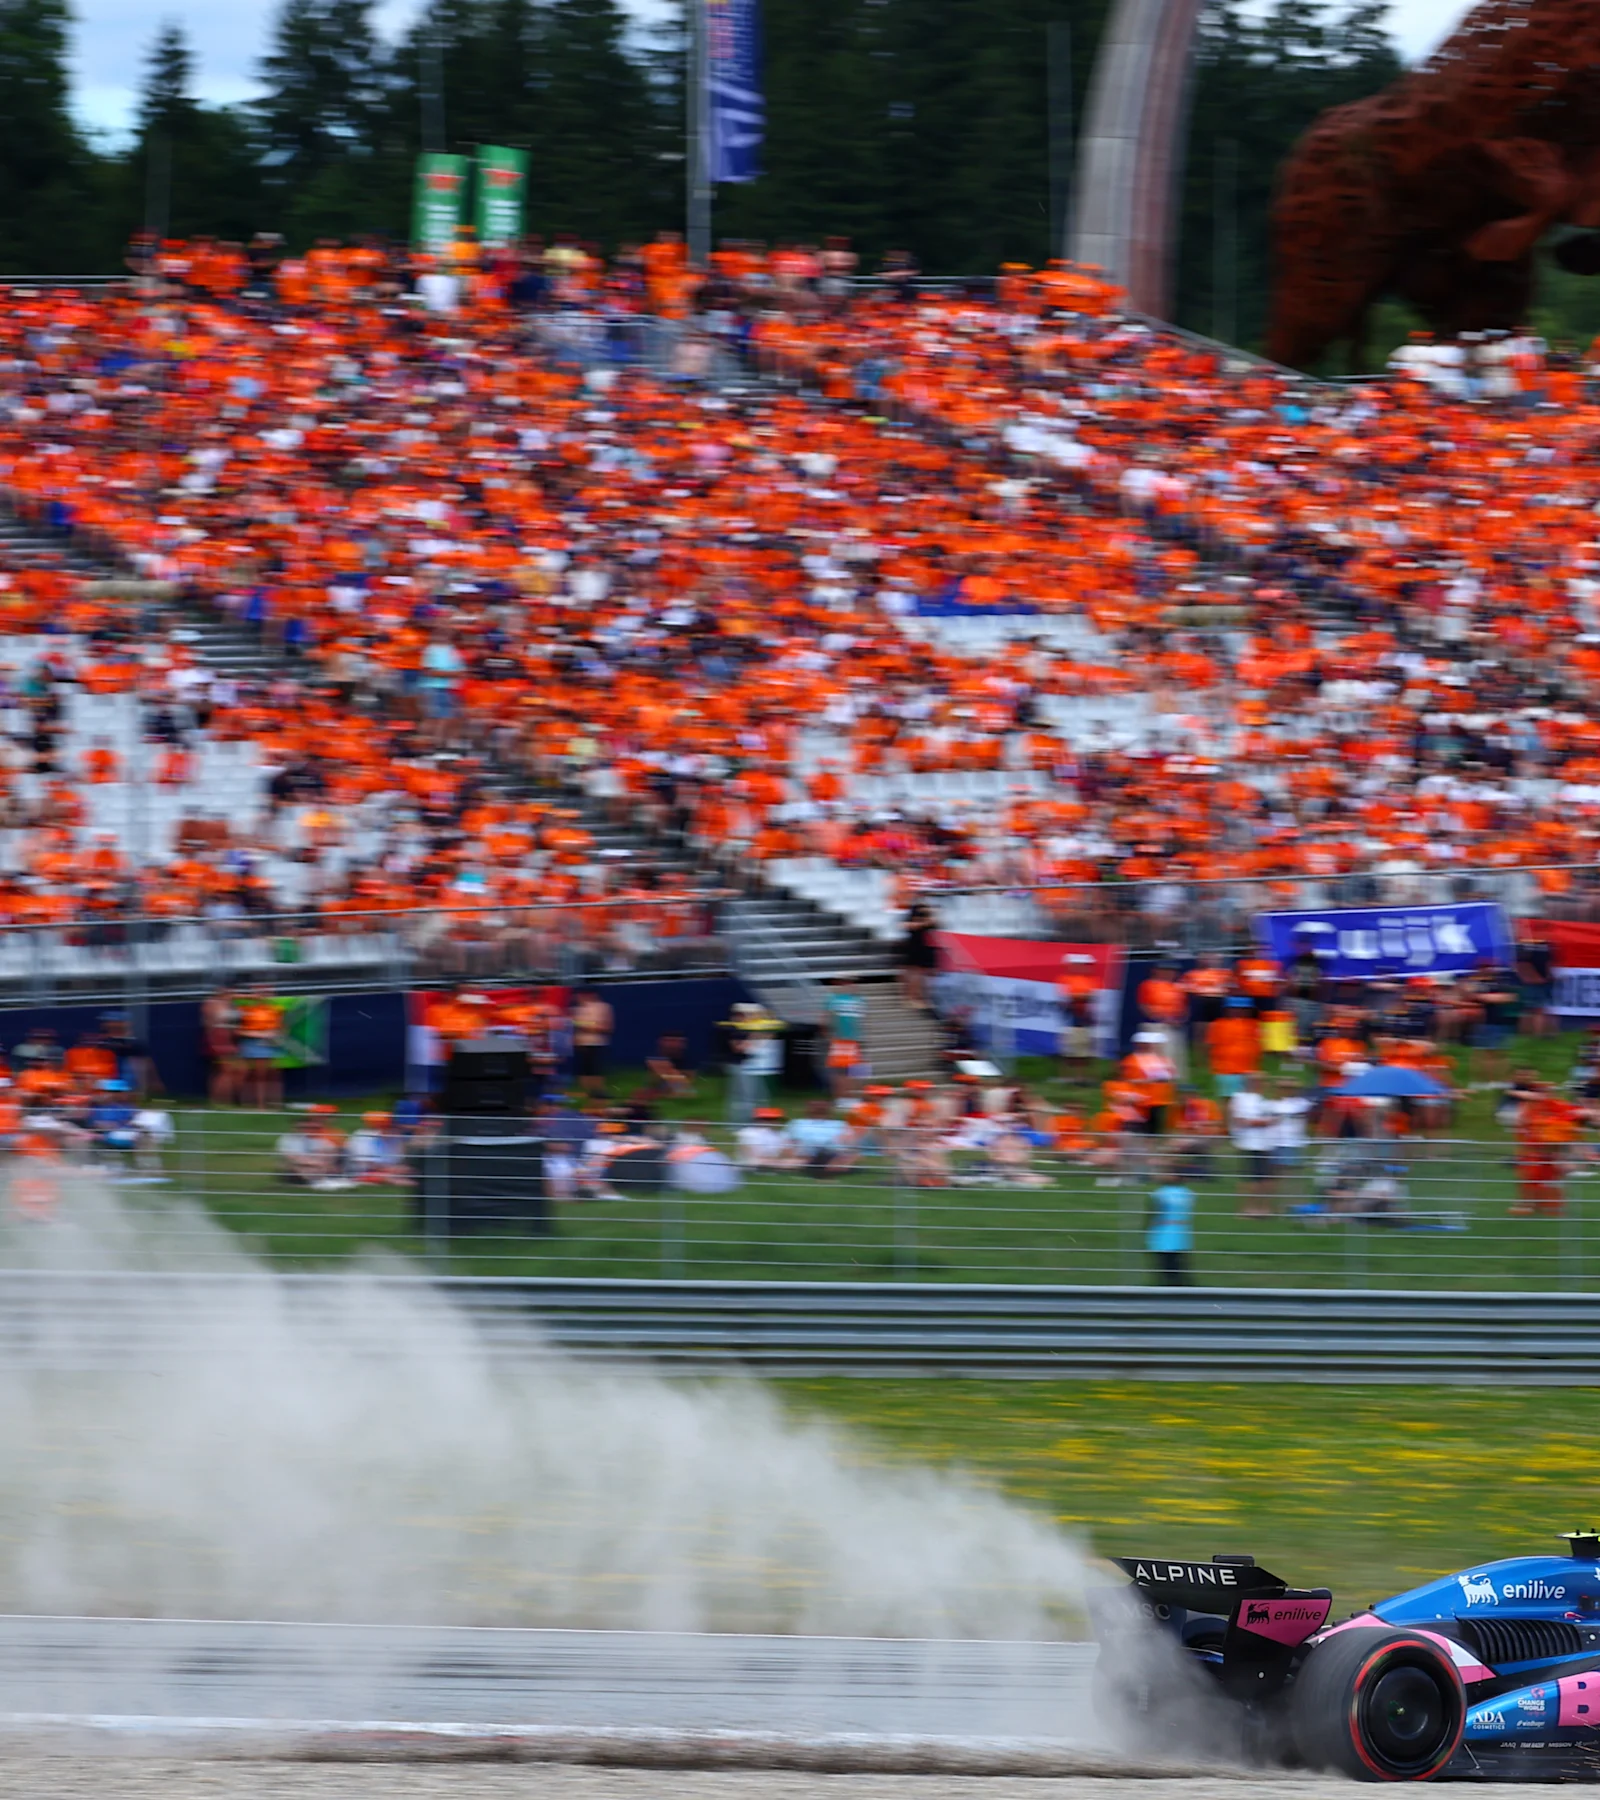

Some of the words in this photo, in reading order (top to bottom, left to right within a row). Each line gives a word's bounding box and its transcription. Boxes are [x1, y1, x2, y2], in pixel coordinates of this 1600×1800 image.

[1135, 1563, 1238, 1586] ALPINE
[1503, 1580, 1565, 1599] enilive
[1274, 1608, 1321, 1622] enilive
[1473, 1711, 1505, 1723] ADA
